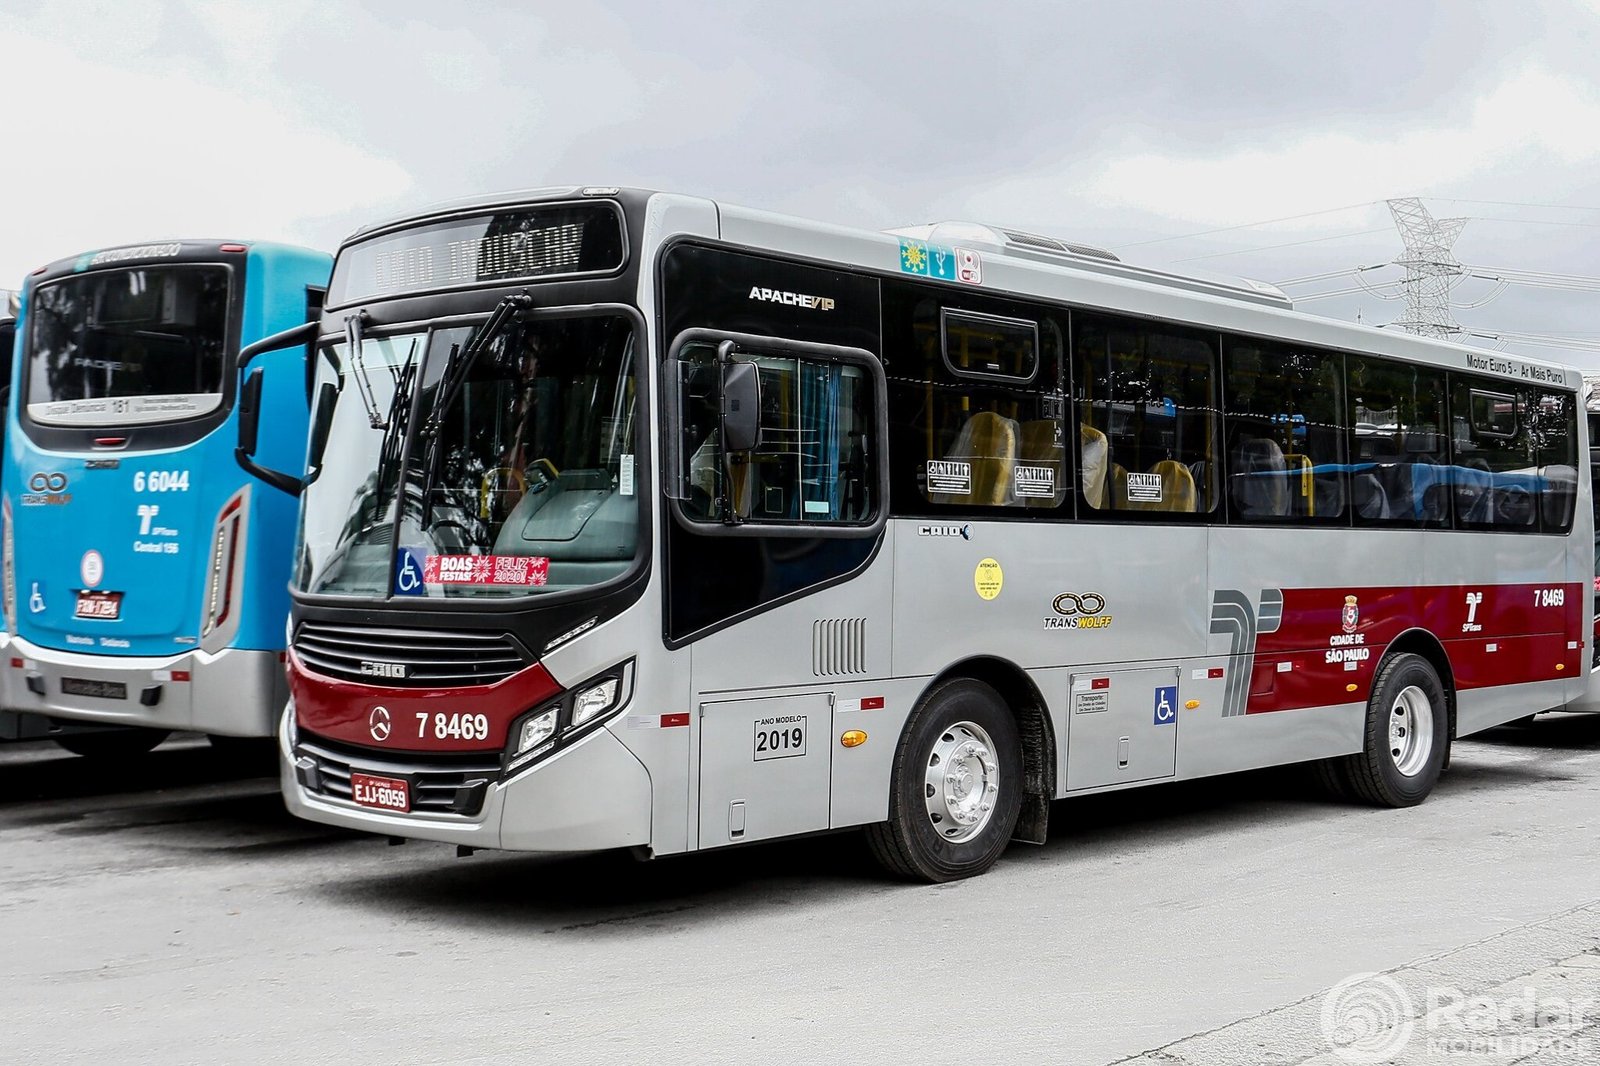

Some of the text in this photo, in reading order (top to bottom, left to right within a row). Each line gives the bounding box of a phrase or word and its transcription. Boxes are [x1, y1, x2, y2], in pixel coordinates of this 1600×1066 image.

[1466, 354, 1488, 370] Motor
[1489, 358, 1506, 374] Euro
[1508, 362, 1513, 374] 5
[1521, 365, 1529, 377] Ar
[1530, 366, 1546, 380] Mais
[1547, 369, 1563, 383] Puro
[134, 470, 190, 493] 6 6044
[918, 525, 962, 537] CAIO
[440, 556, 473, 571] BOAS
[495, 557, 529, 571] FELIZ
[439, 571, 473, 582] FESTAS!
[493, 569, 526, 583] 2020!
[1534, 588, 1564, 607] 7 8469
[1044, 615, 1113, 630] TRANSWOLFF
[1330, 633, 1365, 646] CIDADE DE
[1325, 648, 1369, 664] SÃO PAULO
[361, 661, 406, 678] CAIO
[416, 712, 488, 740] 7 8469
[761, 715, 802, 725] ANO MODELO
[757, 728, 803, 752] 2019
[354, 784, 406, 809] EJJ-6059
